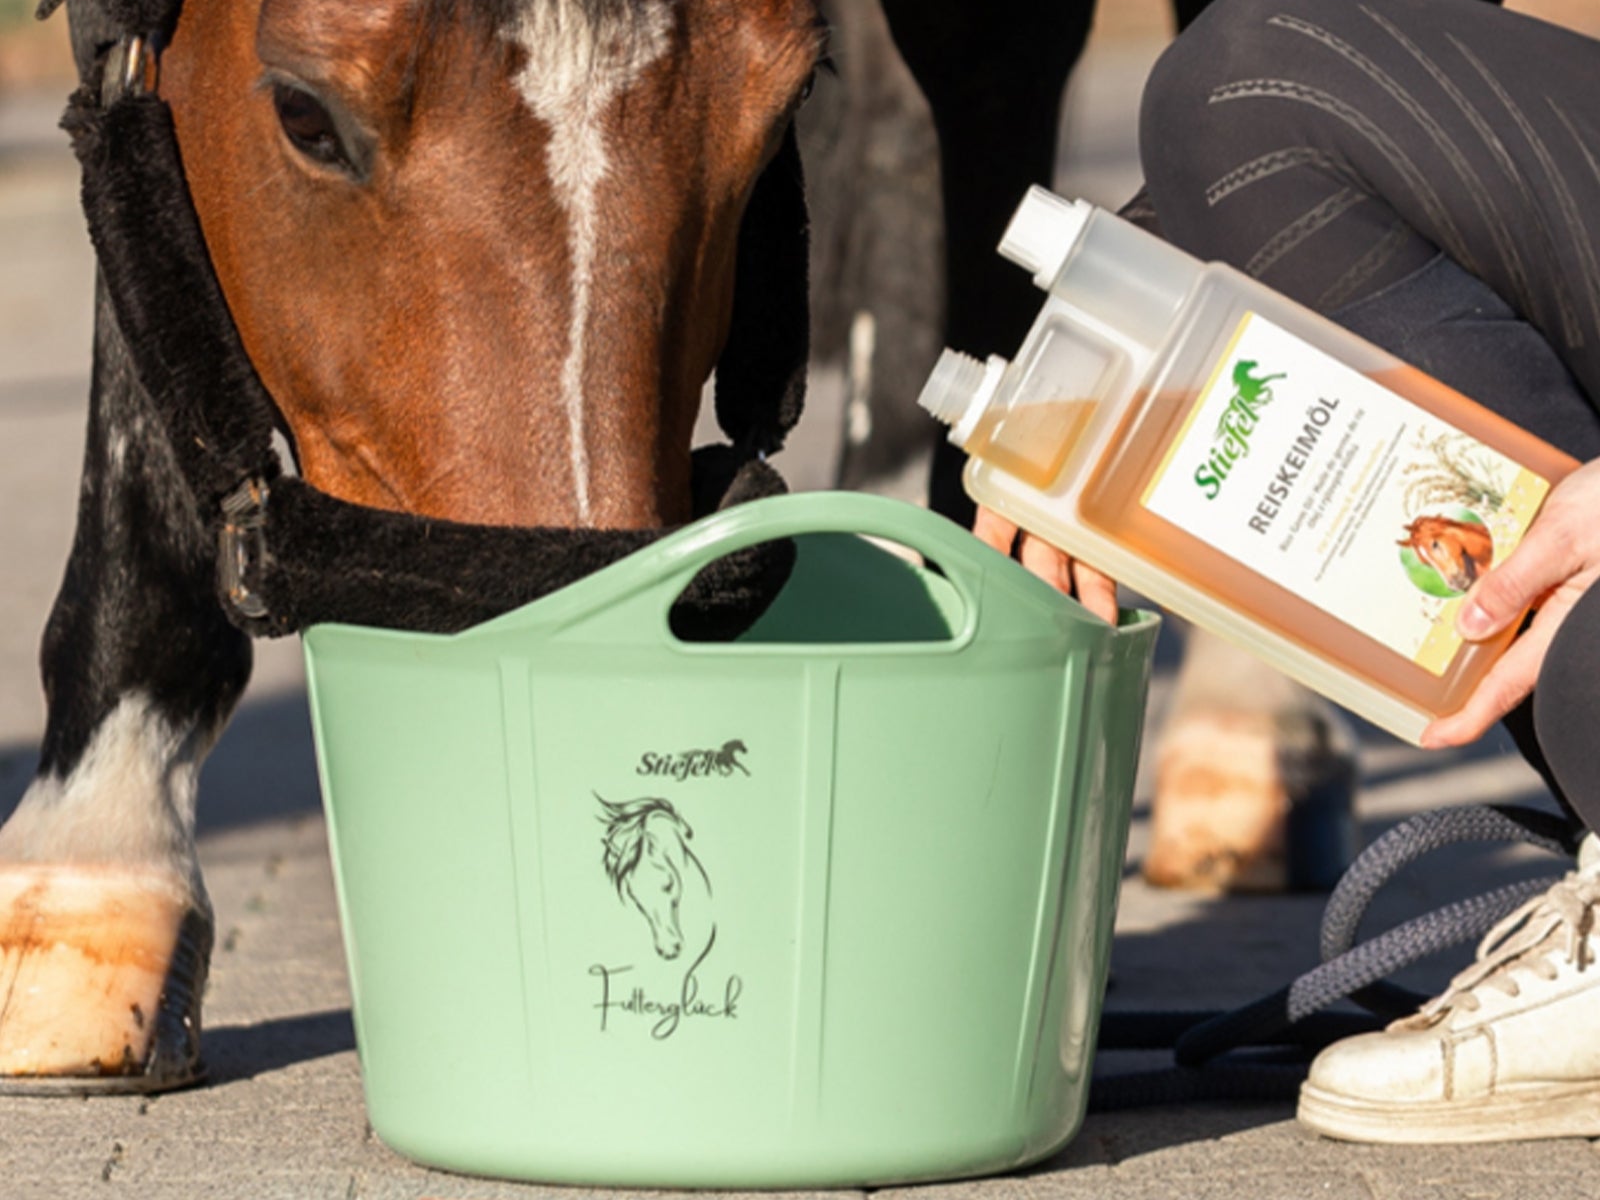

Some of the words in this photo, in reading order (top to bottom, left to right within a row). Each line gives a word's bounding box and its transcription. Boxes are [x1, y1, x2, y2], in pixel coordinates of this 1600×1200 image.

[1195, 397, 1260, 500] Stiefel
[1250, 396, 1340, 535] REISKEIMÖL
[637, 750, 716, 781] Stiefel
[588, 963, 742, 1040] Futterglück
